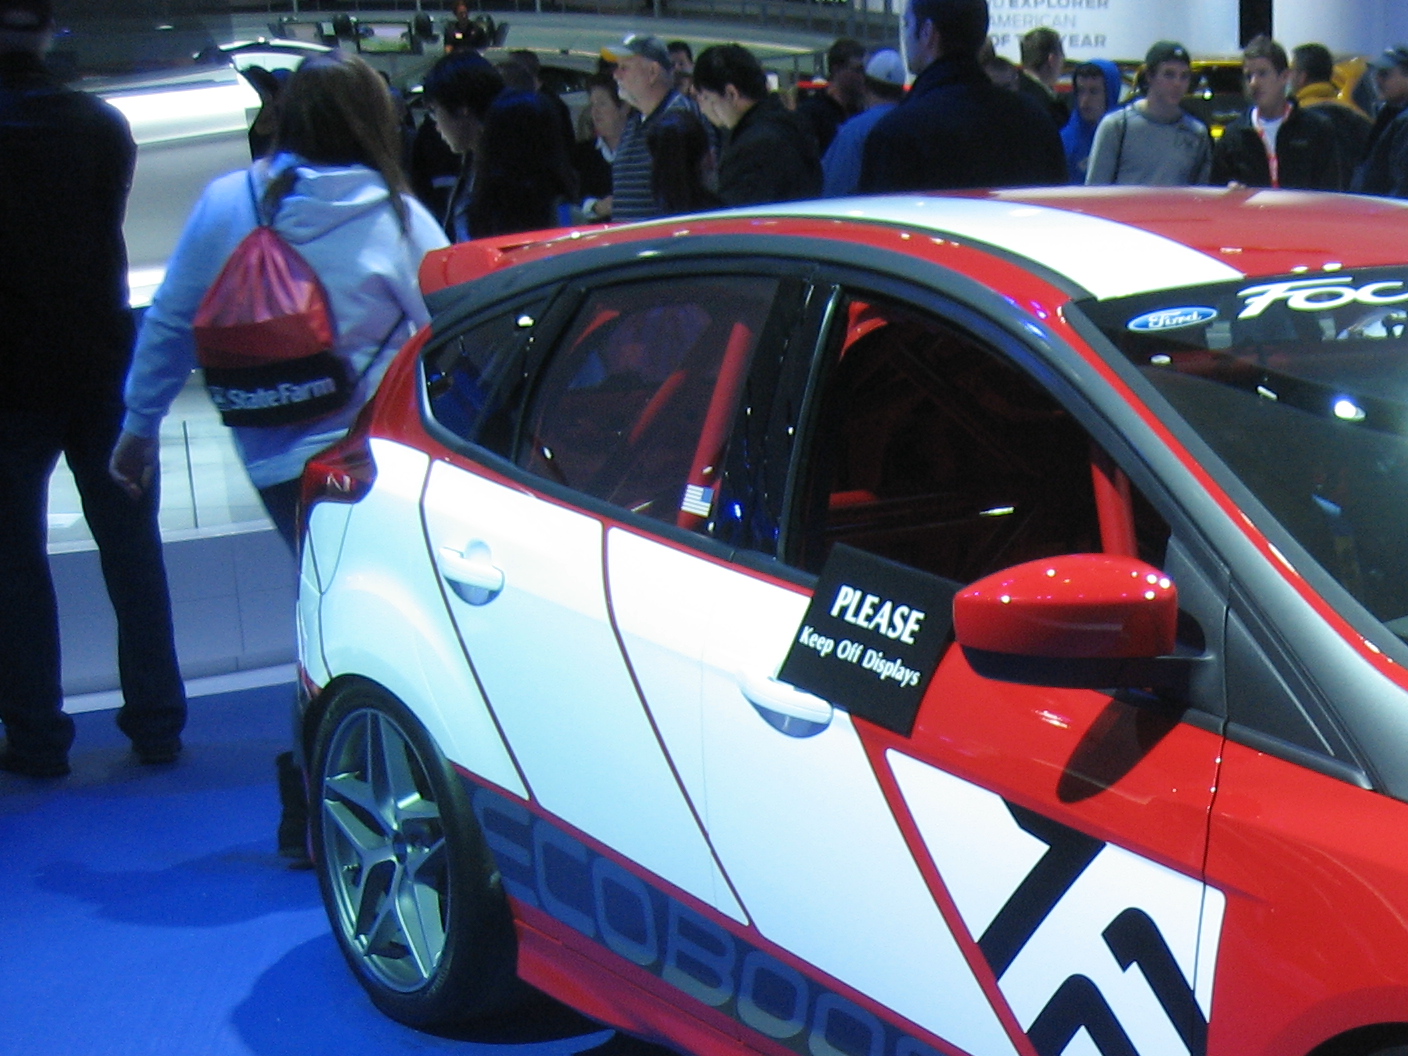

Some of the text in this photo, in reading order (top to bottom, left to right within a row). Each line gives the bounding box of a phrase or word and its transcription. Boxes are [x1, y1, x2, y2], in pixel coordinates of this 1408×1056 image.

[830, 584, 926, 645] PLEASE
[799, 625, 922, 688] Keep Off Displays
